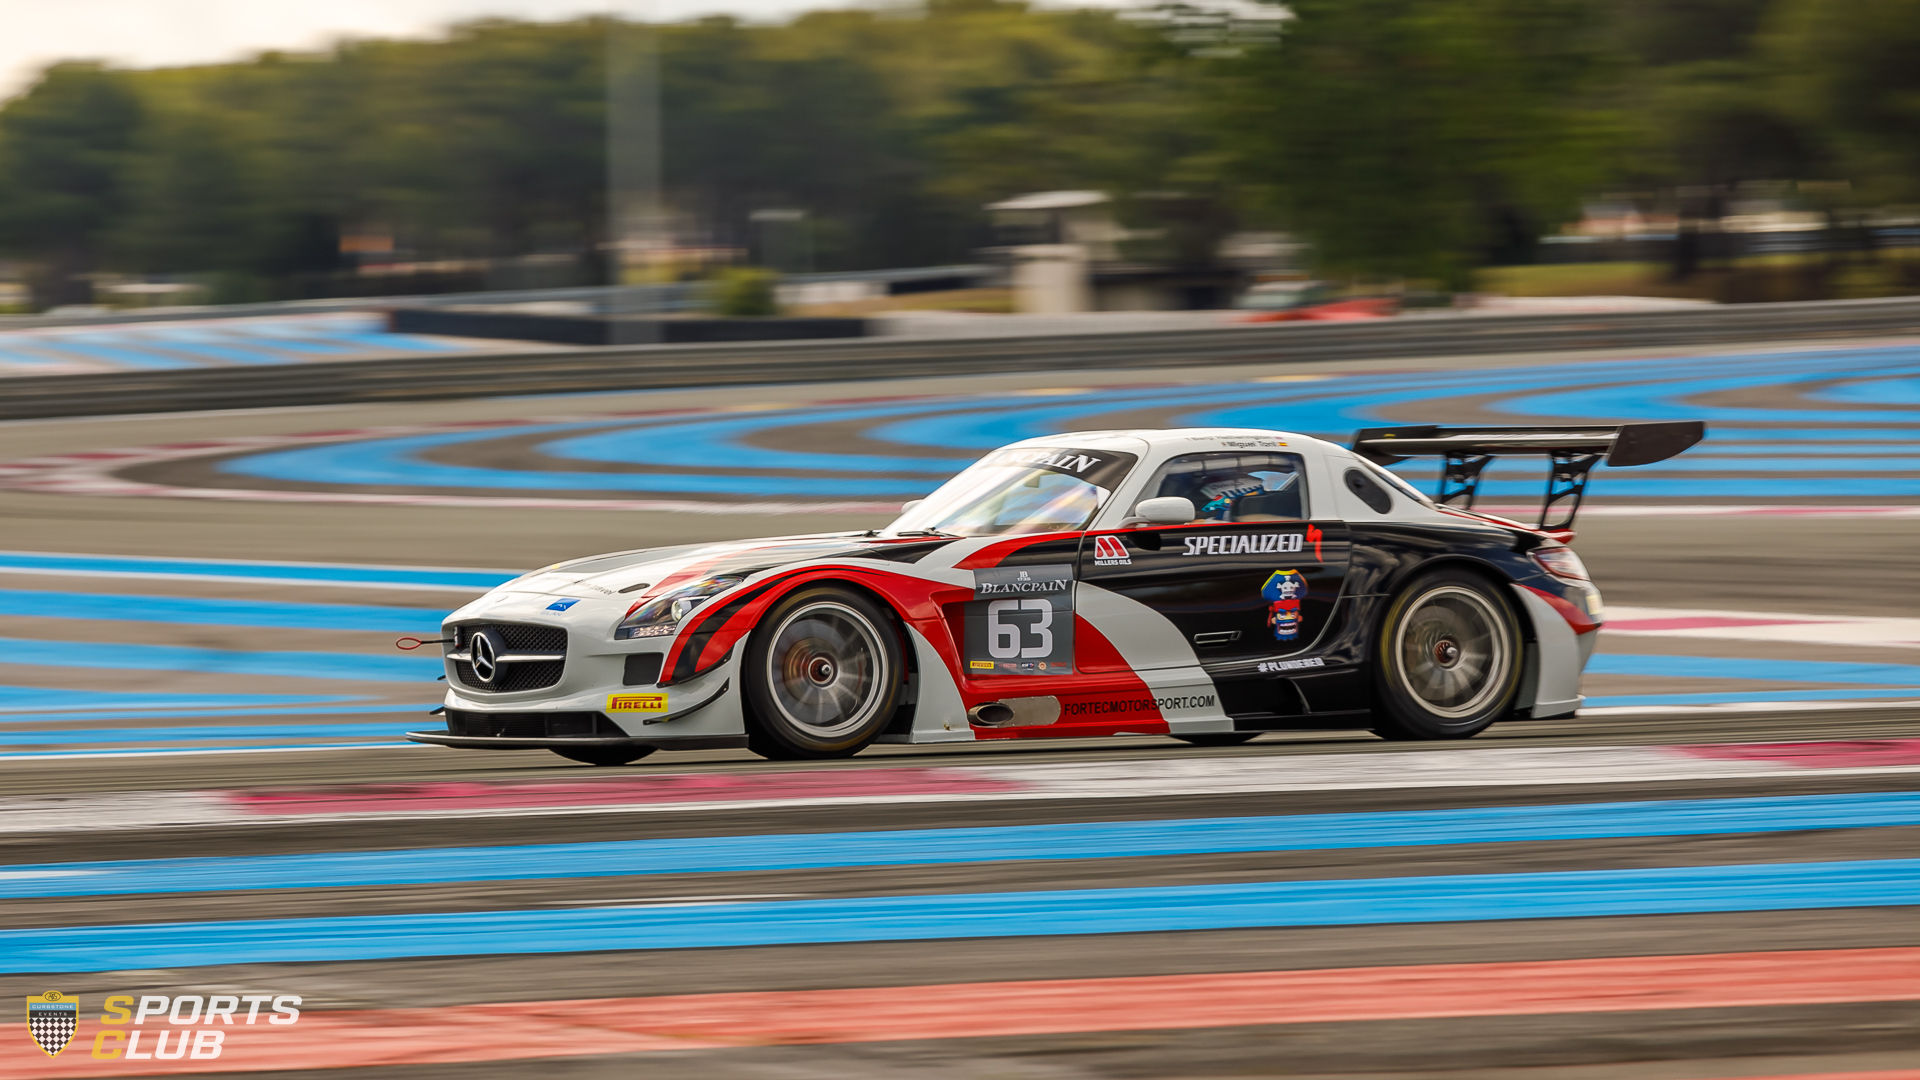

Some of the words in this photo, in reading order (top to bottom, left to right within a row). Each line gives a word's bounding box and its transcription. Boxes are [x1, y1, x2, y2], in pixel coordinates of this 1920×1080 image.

[1183, 533, 1304, 557] SPECIALIZED
[1094, 559, 1119, 567] MILLERS
[980, 579, 1068, 594] BLANCPAIN
[988, 598, 1053, 659] 63
[611, 696, 664, 710] PIRELLI
[1064, 695, 1215, 716] FORTECMOTORSPORT.COM
